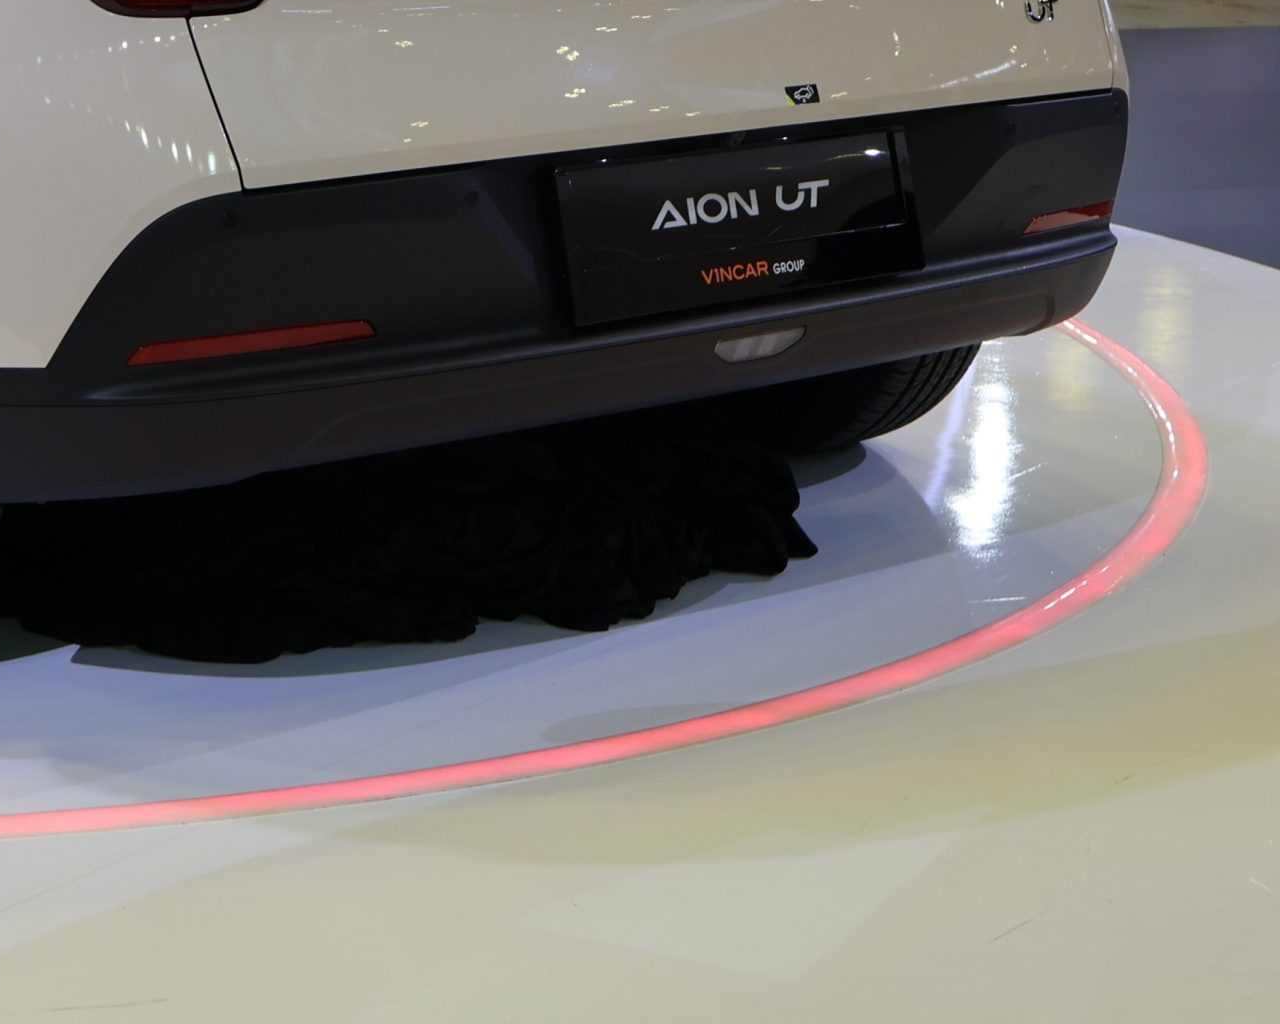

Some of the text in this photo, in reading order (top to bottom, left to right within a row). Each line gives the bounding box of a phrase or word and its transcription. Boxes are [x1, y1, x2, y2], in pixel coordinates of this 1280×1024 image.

[651, 179, 830, 231] AION UT
[773, 259, 805, 275] GROUP
